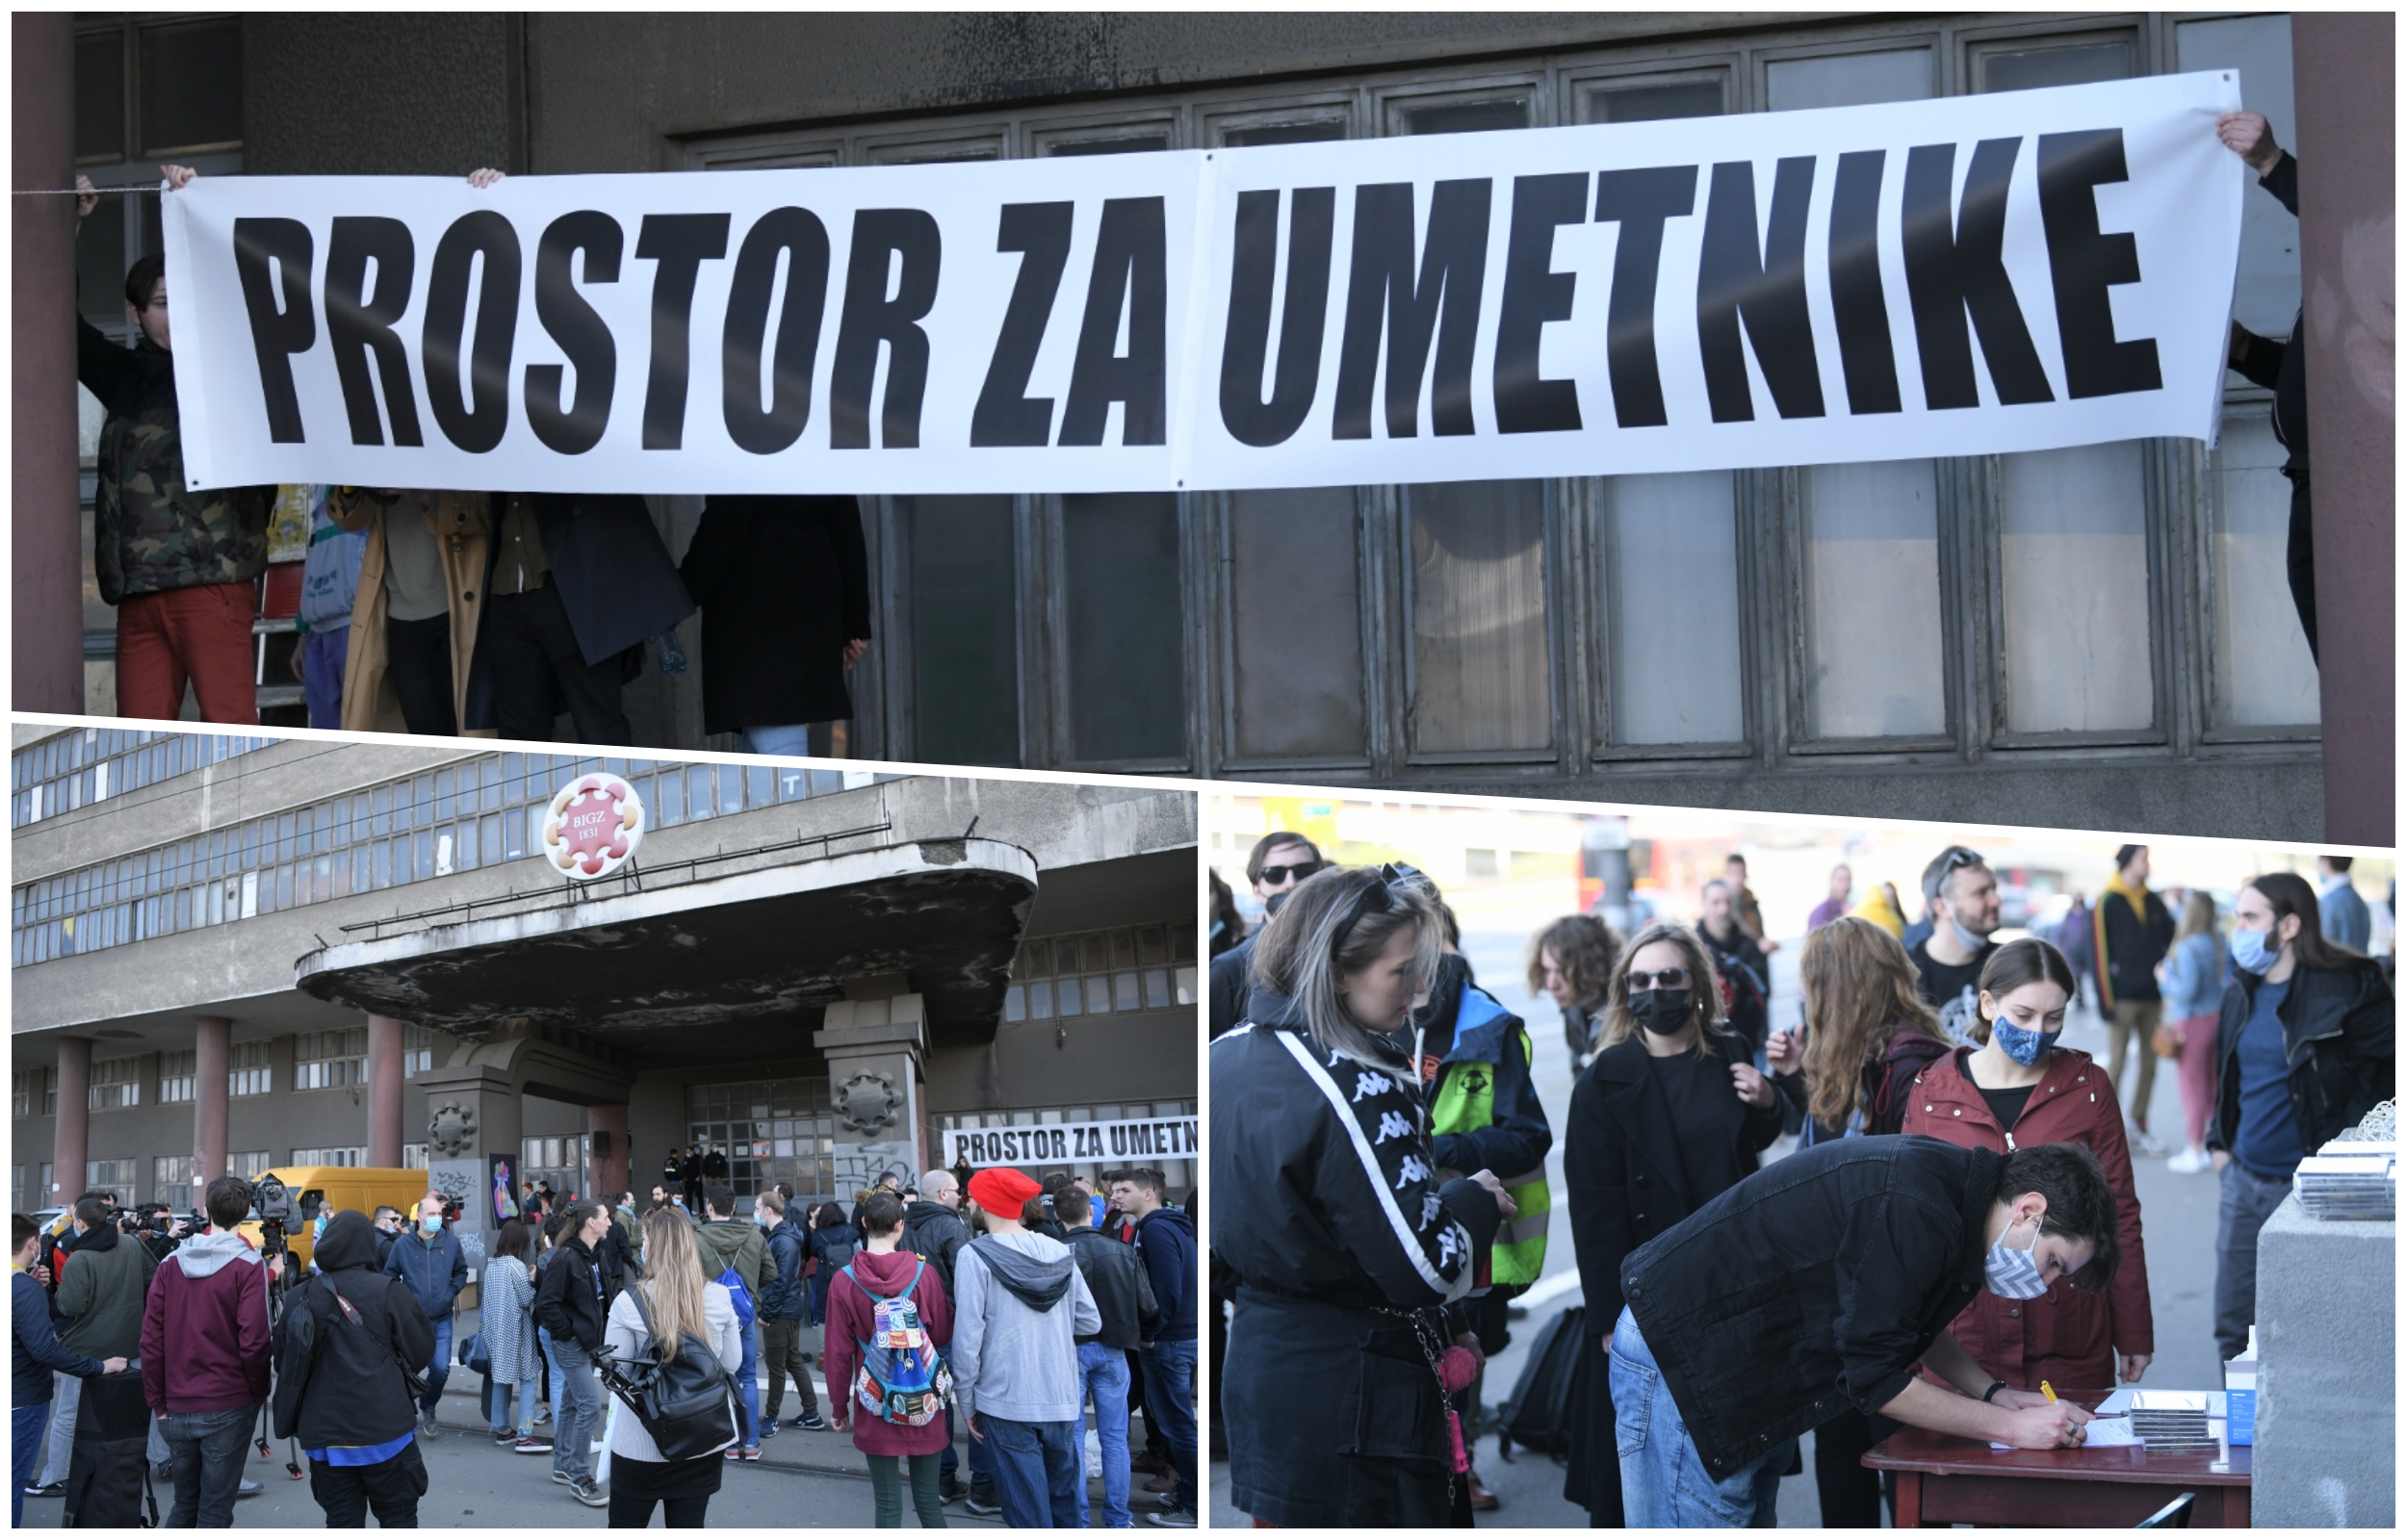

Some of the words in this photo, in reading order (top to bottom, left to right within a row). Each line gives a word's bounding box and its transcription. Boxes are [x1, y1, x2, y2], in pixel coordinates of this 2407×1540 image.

[234, 206, 941, 455] PROSTOR
[971, 196, 1166, 447] ZA
[1220, 128, 2162, 447] UMETNIKE
[573, 810, 606, 829] BIGZ
[579, 828, 598, 841] 1831
[956, 1129, 1067, 1162] PROSTOR
[1073, 1127, 1104, 1158] ZA
[1110, 1120, 1198, 1156] UMETN
